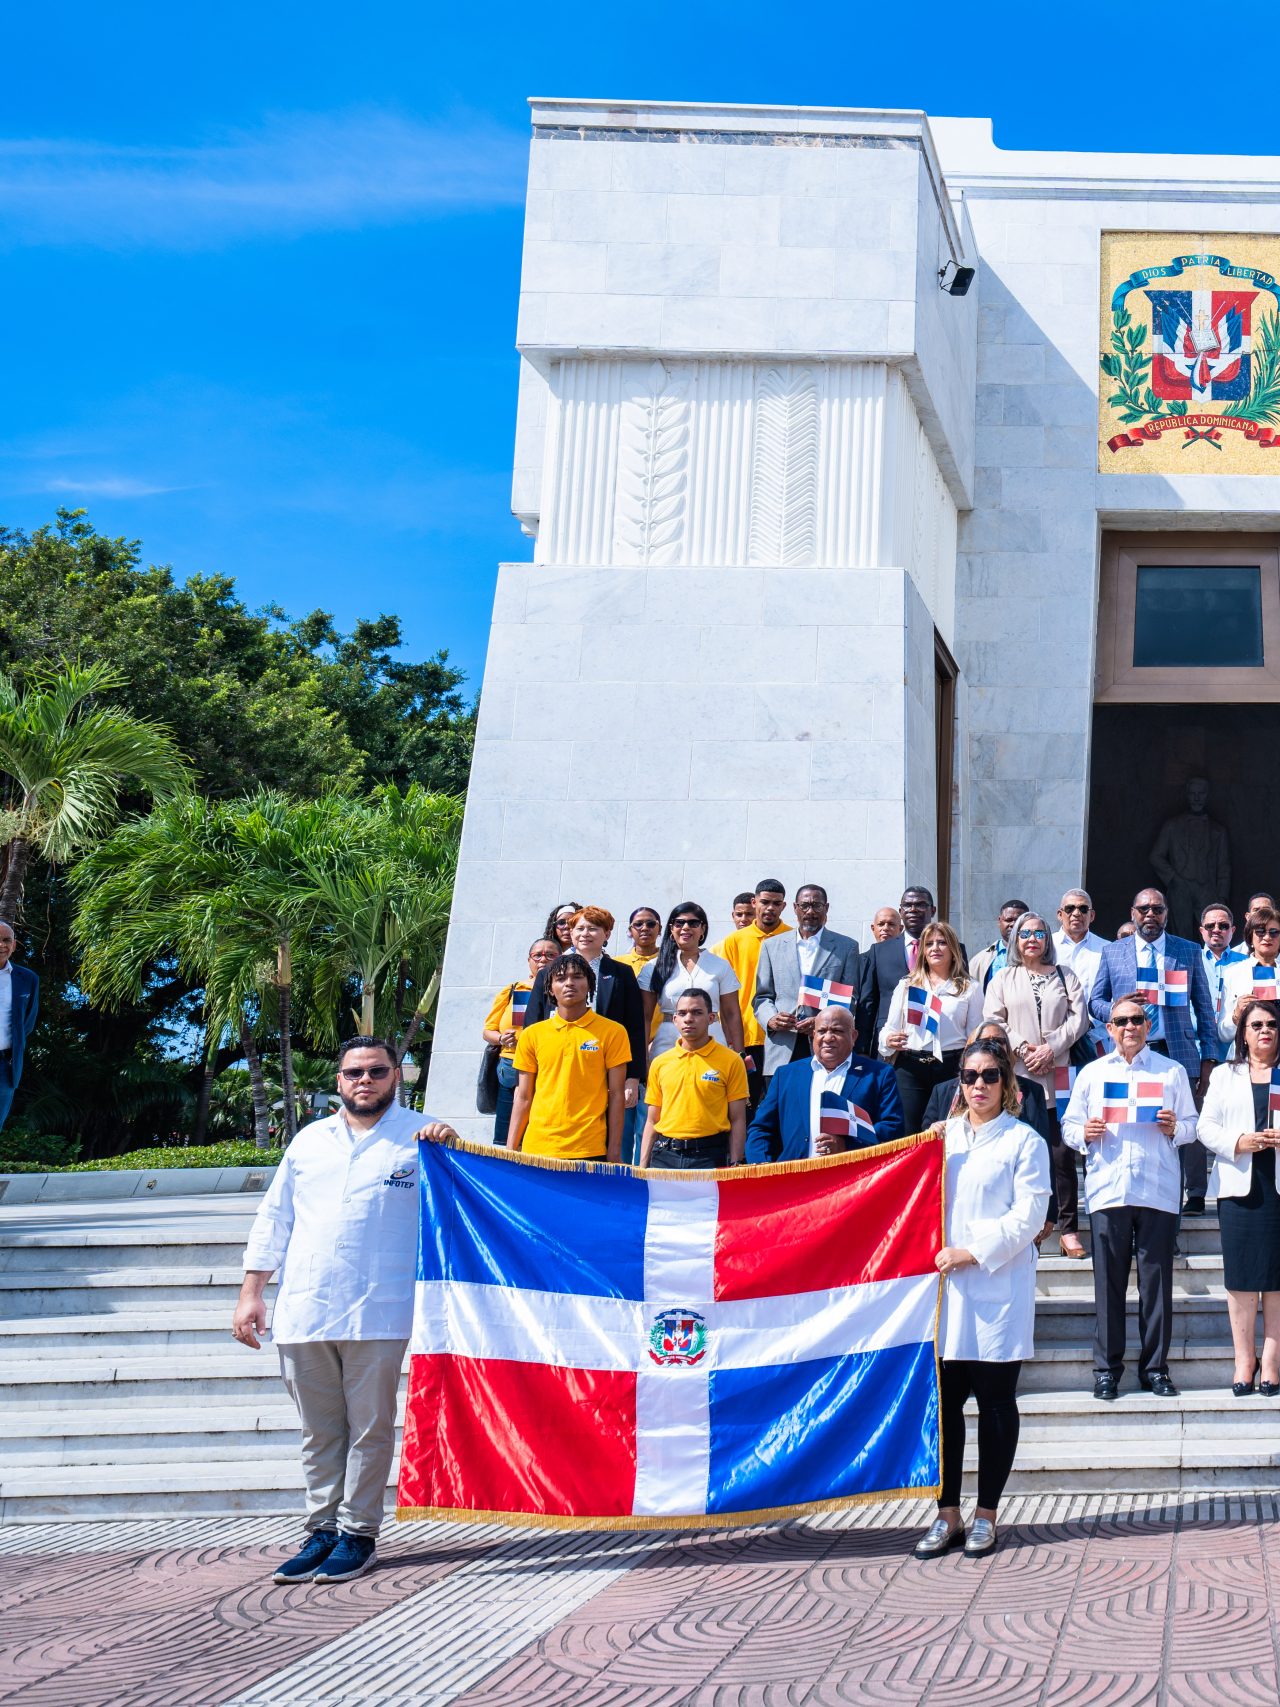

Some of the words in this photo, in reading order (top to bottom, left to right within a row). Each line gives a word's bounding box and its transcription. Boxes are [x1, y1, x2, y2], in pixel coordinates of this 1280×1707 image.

[1142, 267, 1167, 279] DIOS
[1181, 256, 1220, 266] PATRIA
[1227, 267, 1273, 285] LIBERTAD
[1148, 416, 1198, 433] REPUBLICA
[1200, 416, 1255, 432] DOMINICANA
[384, 1179, 415, 1189] INFOTEP
